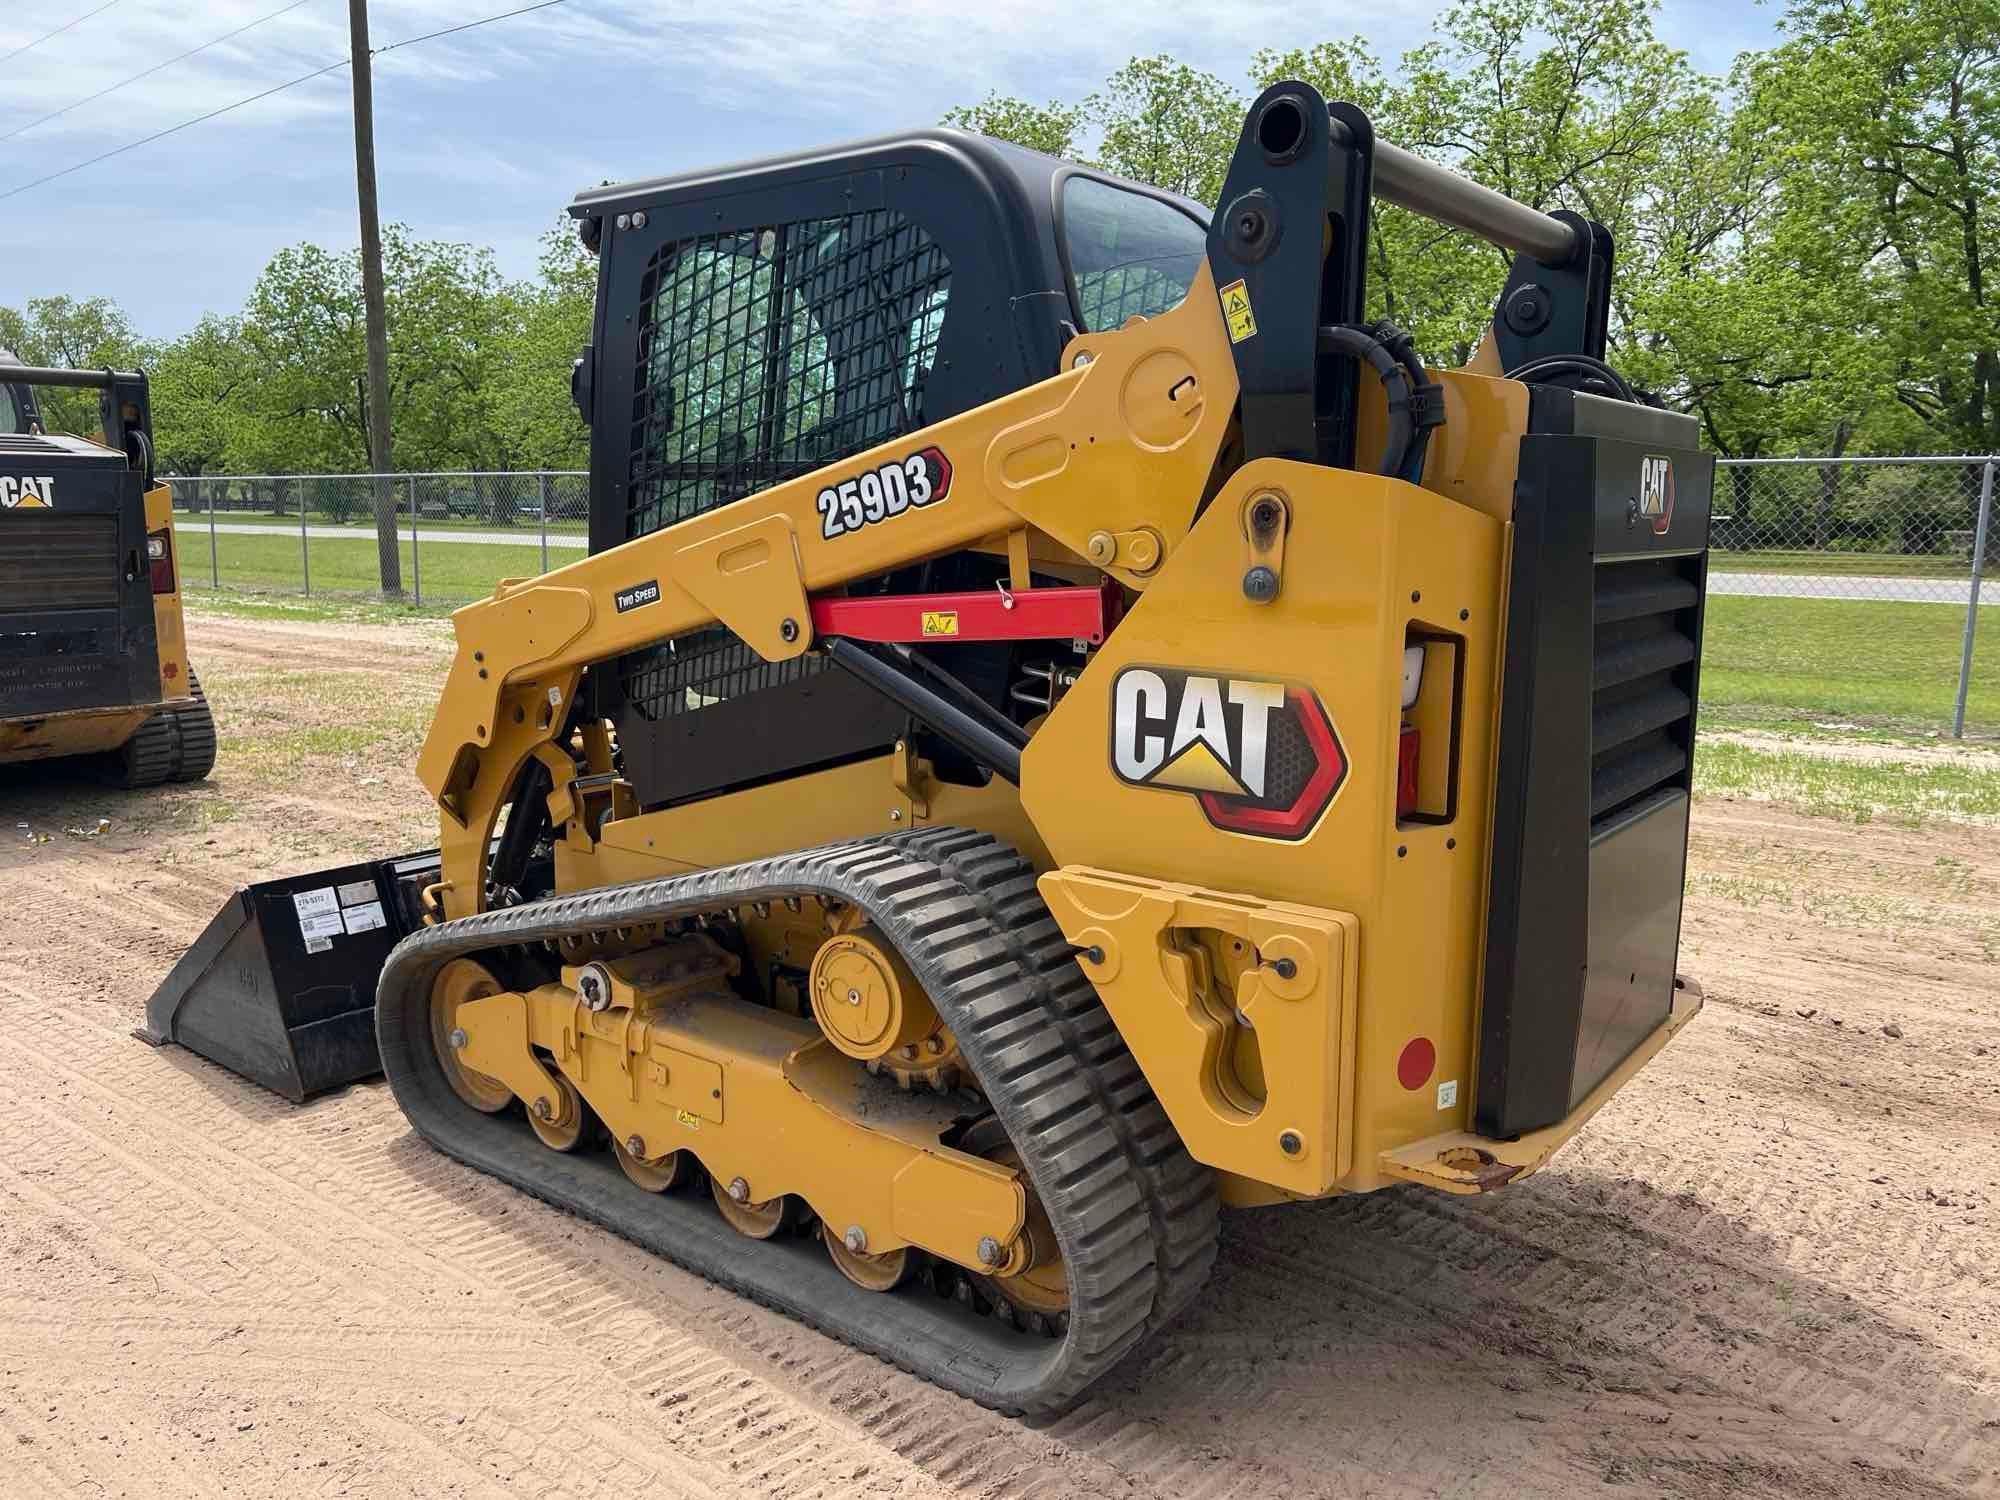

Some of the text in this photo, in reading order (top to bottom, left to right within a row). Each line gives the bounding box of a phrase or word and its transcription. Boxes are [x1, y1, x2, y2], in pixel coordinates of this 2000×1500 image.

[0, 476, 54, 508] CAT
[818, 455, 932, 538] 259D3
[1640, 457, 1668, 513] CAT
[1114, 669, 1285, 798] CAT
